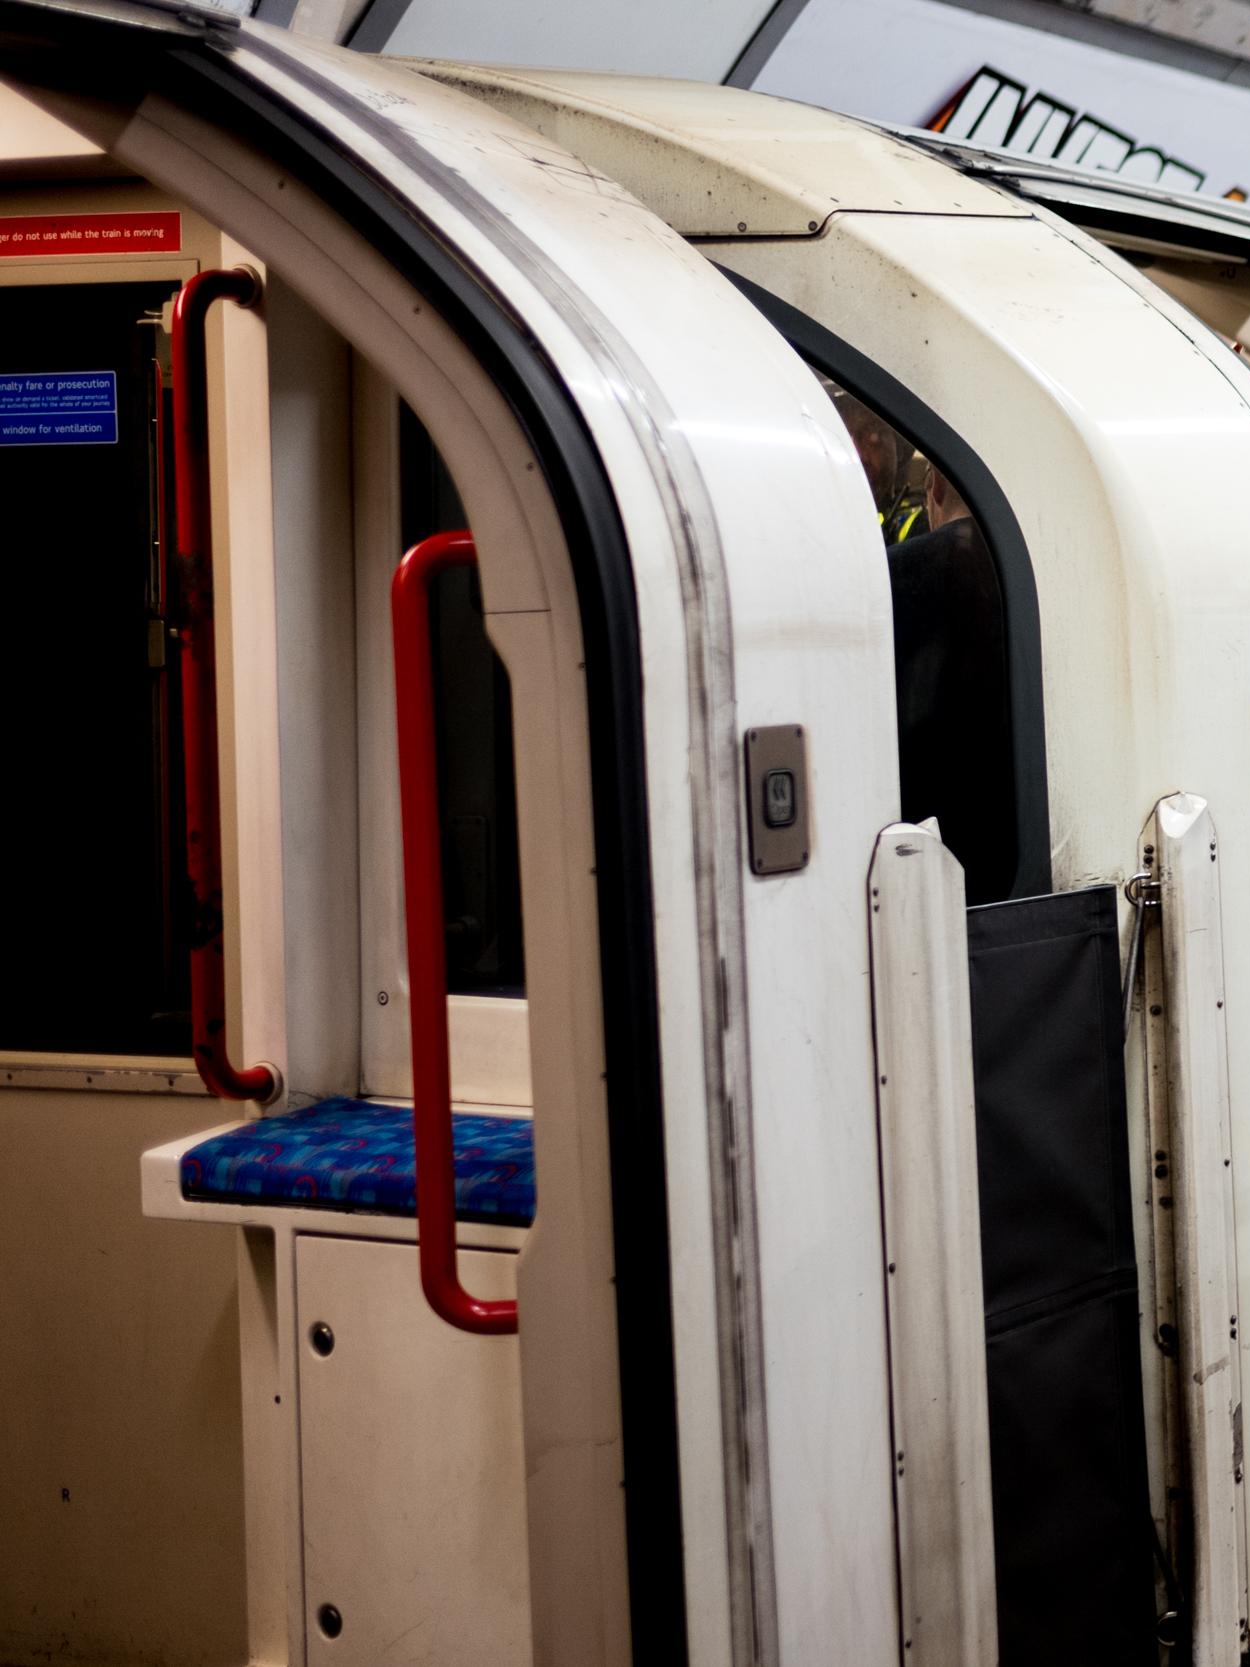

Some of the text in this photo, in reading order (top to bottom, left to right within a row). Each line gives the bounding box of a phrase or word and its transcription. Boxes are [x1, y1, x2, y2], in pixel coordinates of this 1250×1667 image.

[12, 232, 24, 241] do
[26, 232, 40, 241] not
[60, 230, 82, 239] while
[85, 230, 99, 239] the
[102, 229, 121, 238] train
[124, 229, 131, 237] is
[134, 228, 164, 239] moving
[26, 380, 43, 390] fare
[58, 379, 111, 391] prosecution
[3, 423, 103, 434] window for ventilation
